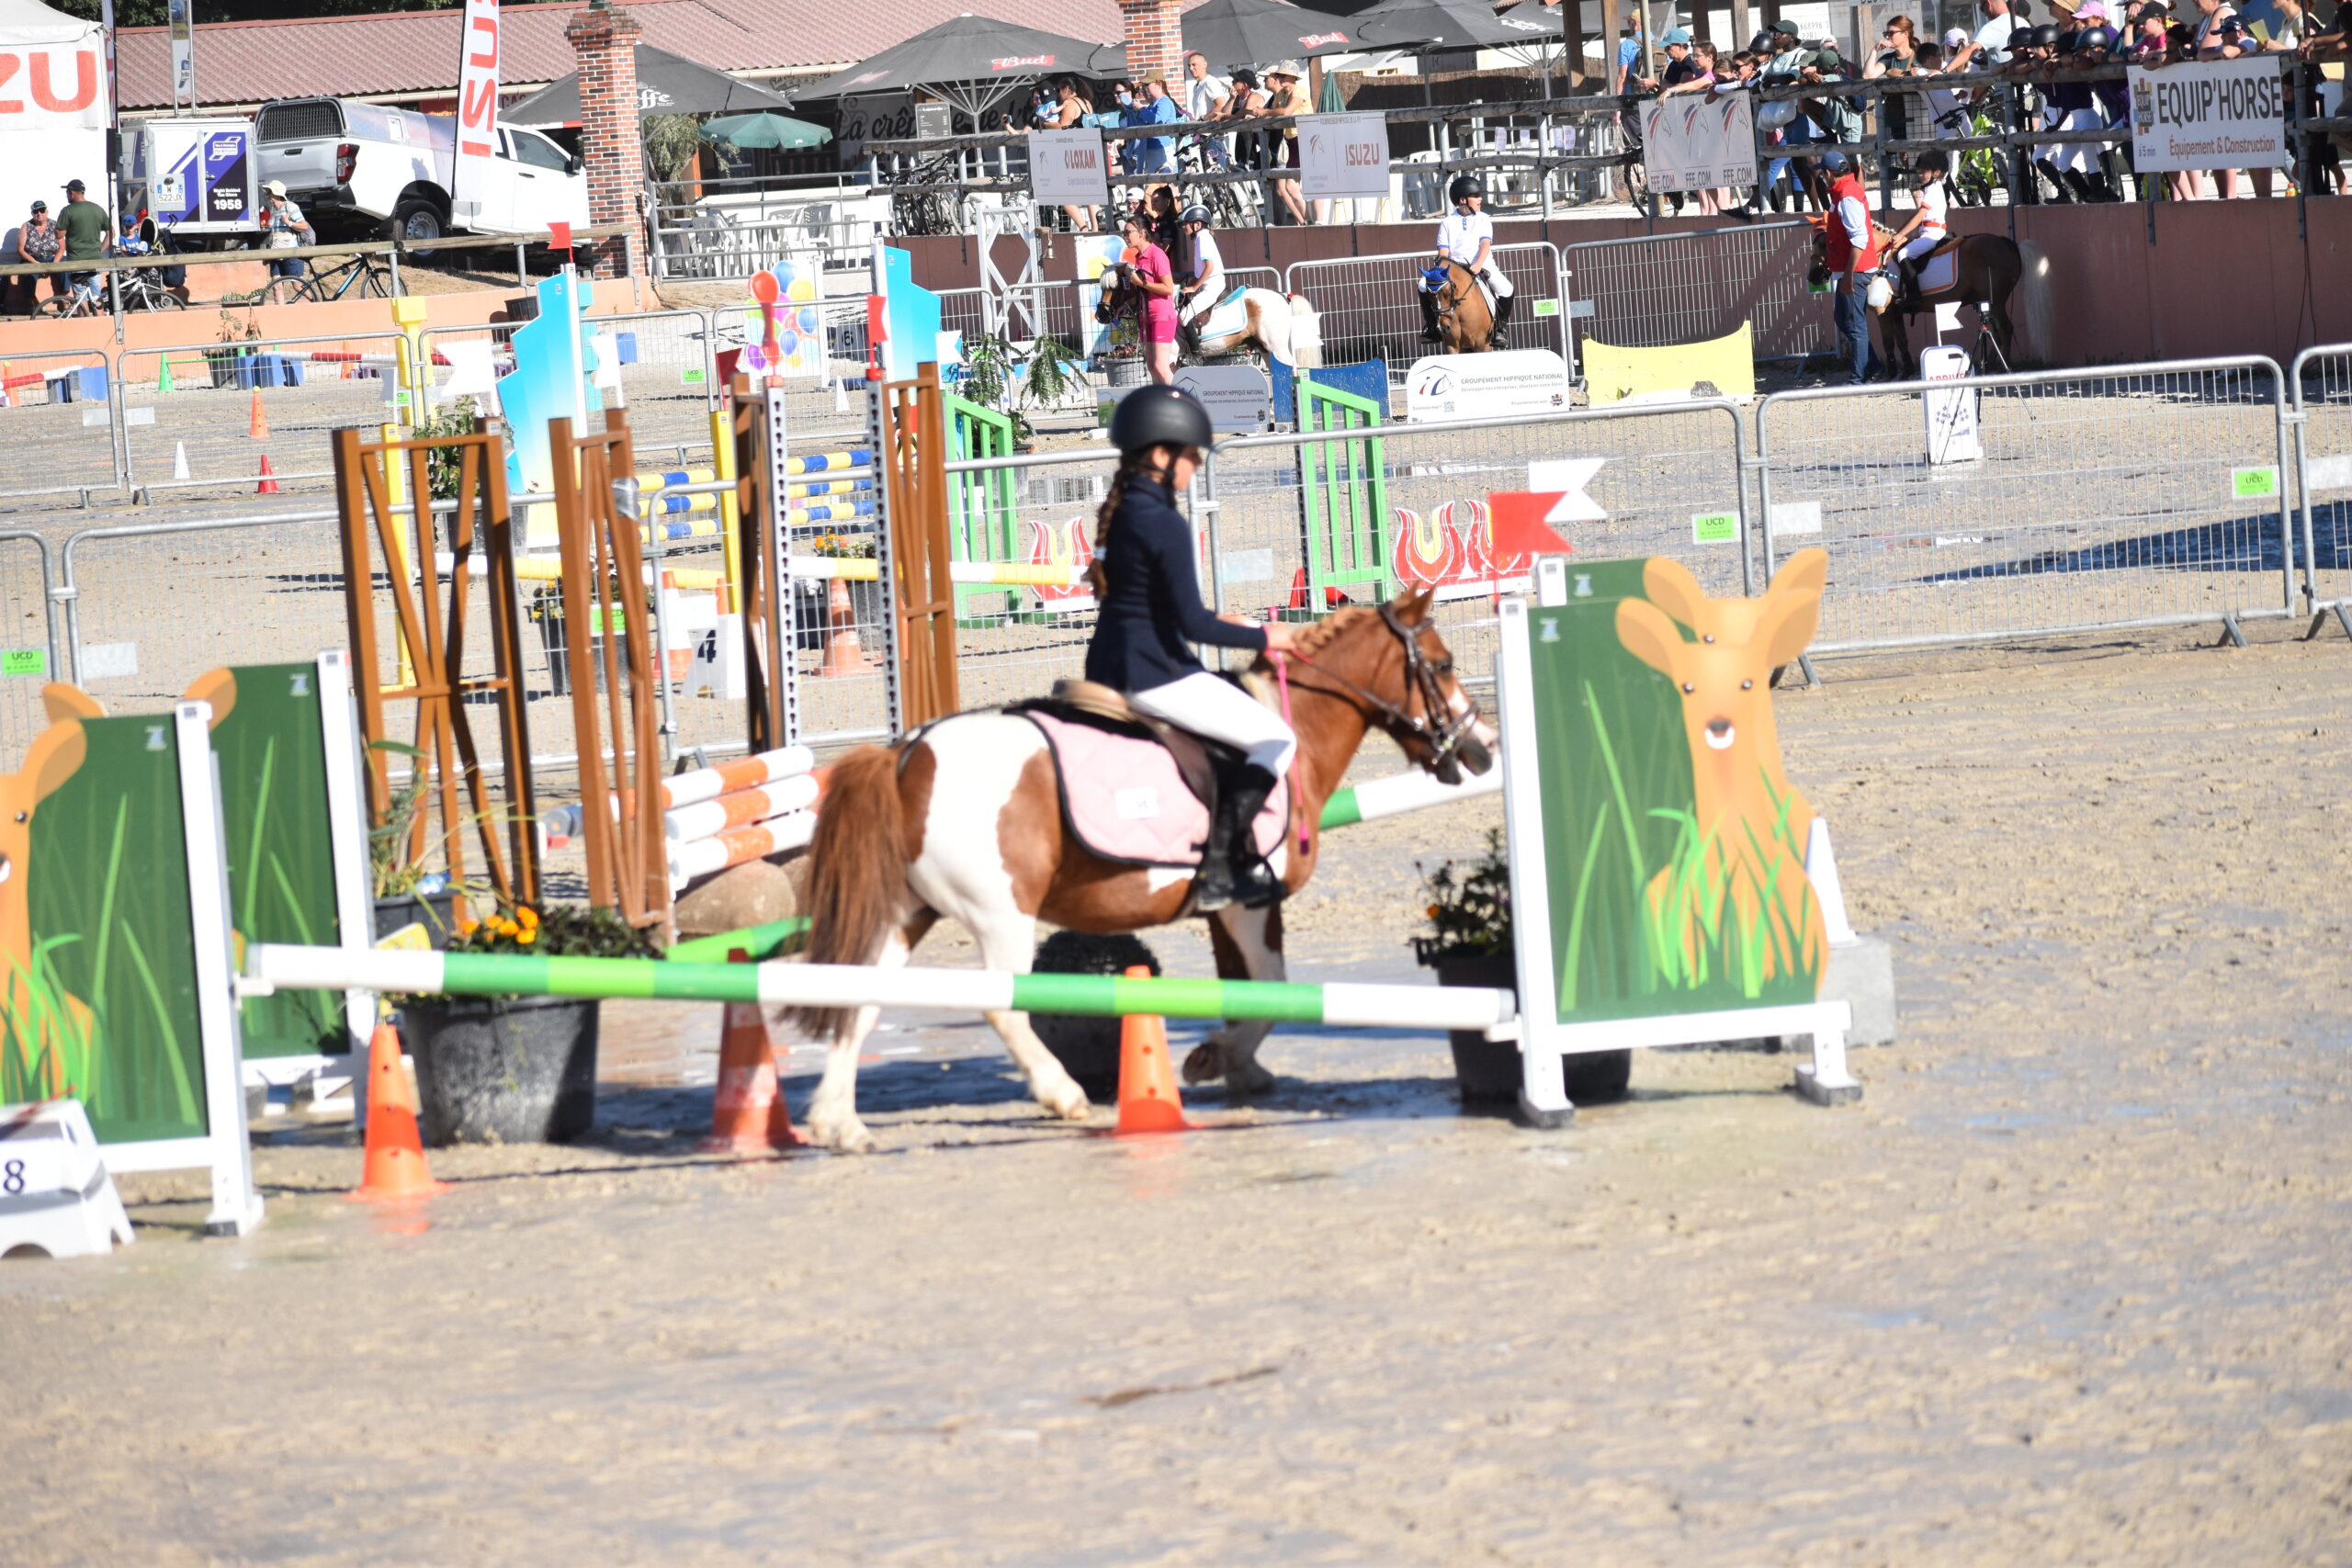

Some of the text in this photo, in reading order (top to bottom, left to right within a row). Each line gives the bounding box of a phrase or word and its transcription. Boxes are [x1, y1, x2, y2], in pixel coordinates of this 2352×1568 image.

[1298, 32, 1341, 44] Bud
[991, 55, 1047, 67] Bud
[462, 0, 499, 158] ISU
[2156, 76, 2283, 129] EQUIP'HORSE
[1345, 142, 1380, 166] ISUZU
[2169, 135, 2276, 161] Équipement & Construction
[1070, 149, 1097, 169] LOXAM
[1650, 175, 1676, 190] FFE.COM
[1685, 170, 1712, 186] FFE.COM
[1724, 167, 1753, 184] FFE.COM
[213, 198, 243, 209] 1958
[841, 331, 854, 346] 6
[1461, 376, 1502, 385] GROUPEMENT
[1504, 374, 1532, 383] HIPPIQUE
[2245, 476, 2263, 484] UCD
[1705, 517, 1725, 526] UCD
[697, 629, 717, 663] 4
[12, 651, 34, 660] UCD
[3, 1159, 25, 1193] 8
